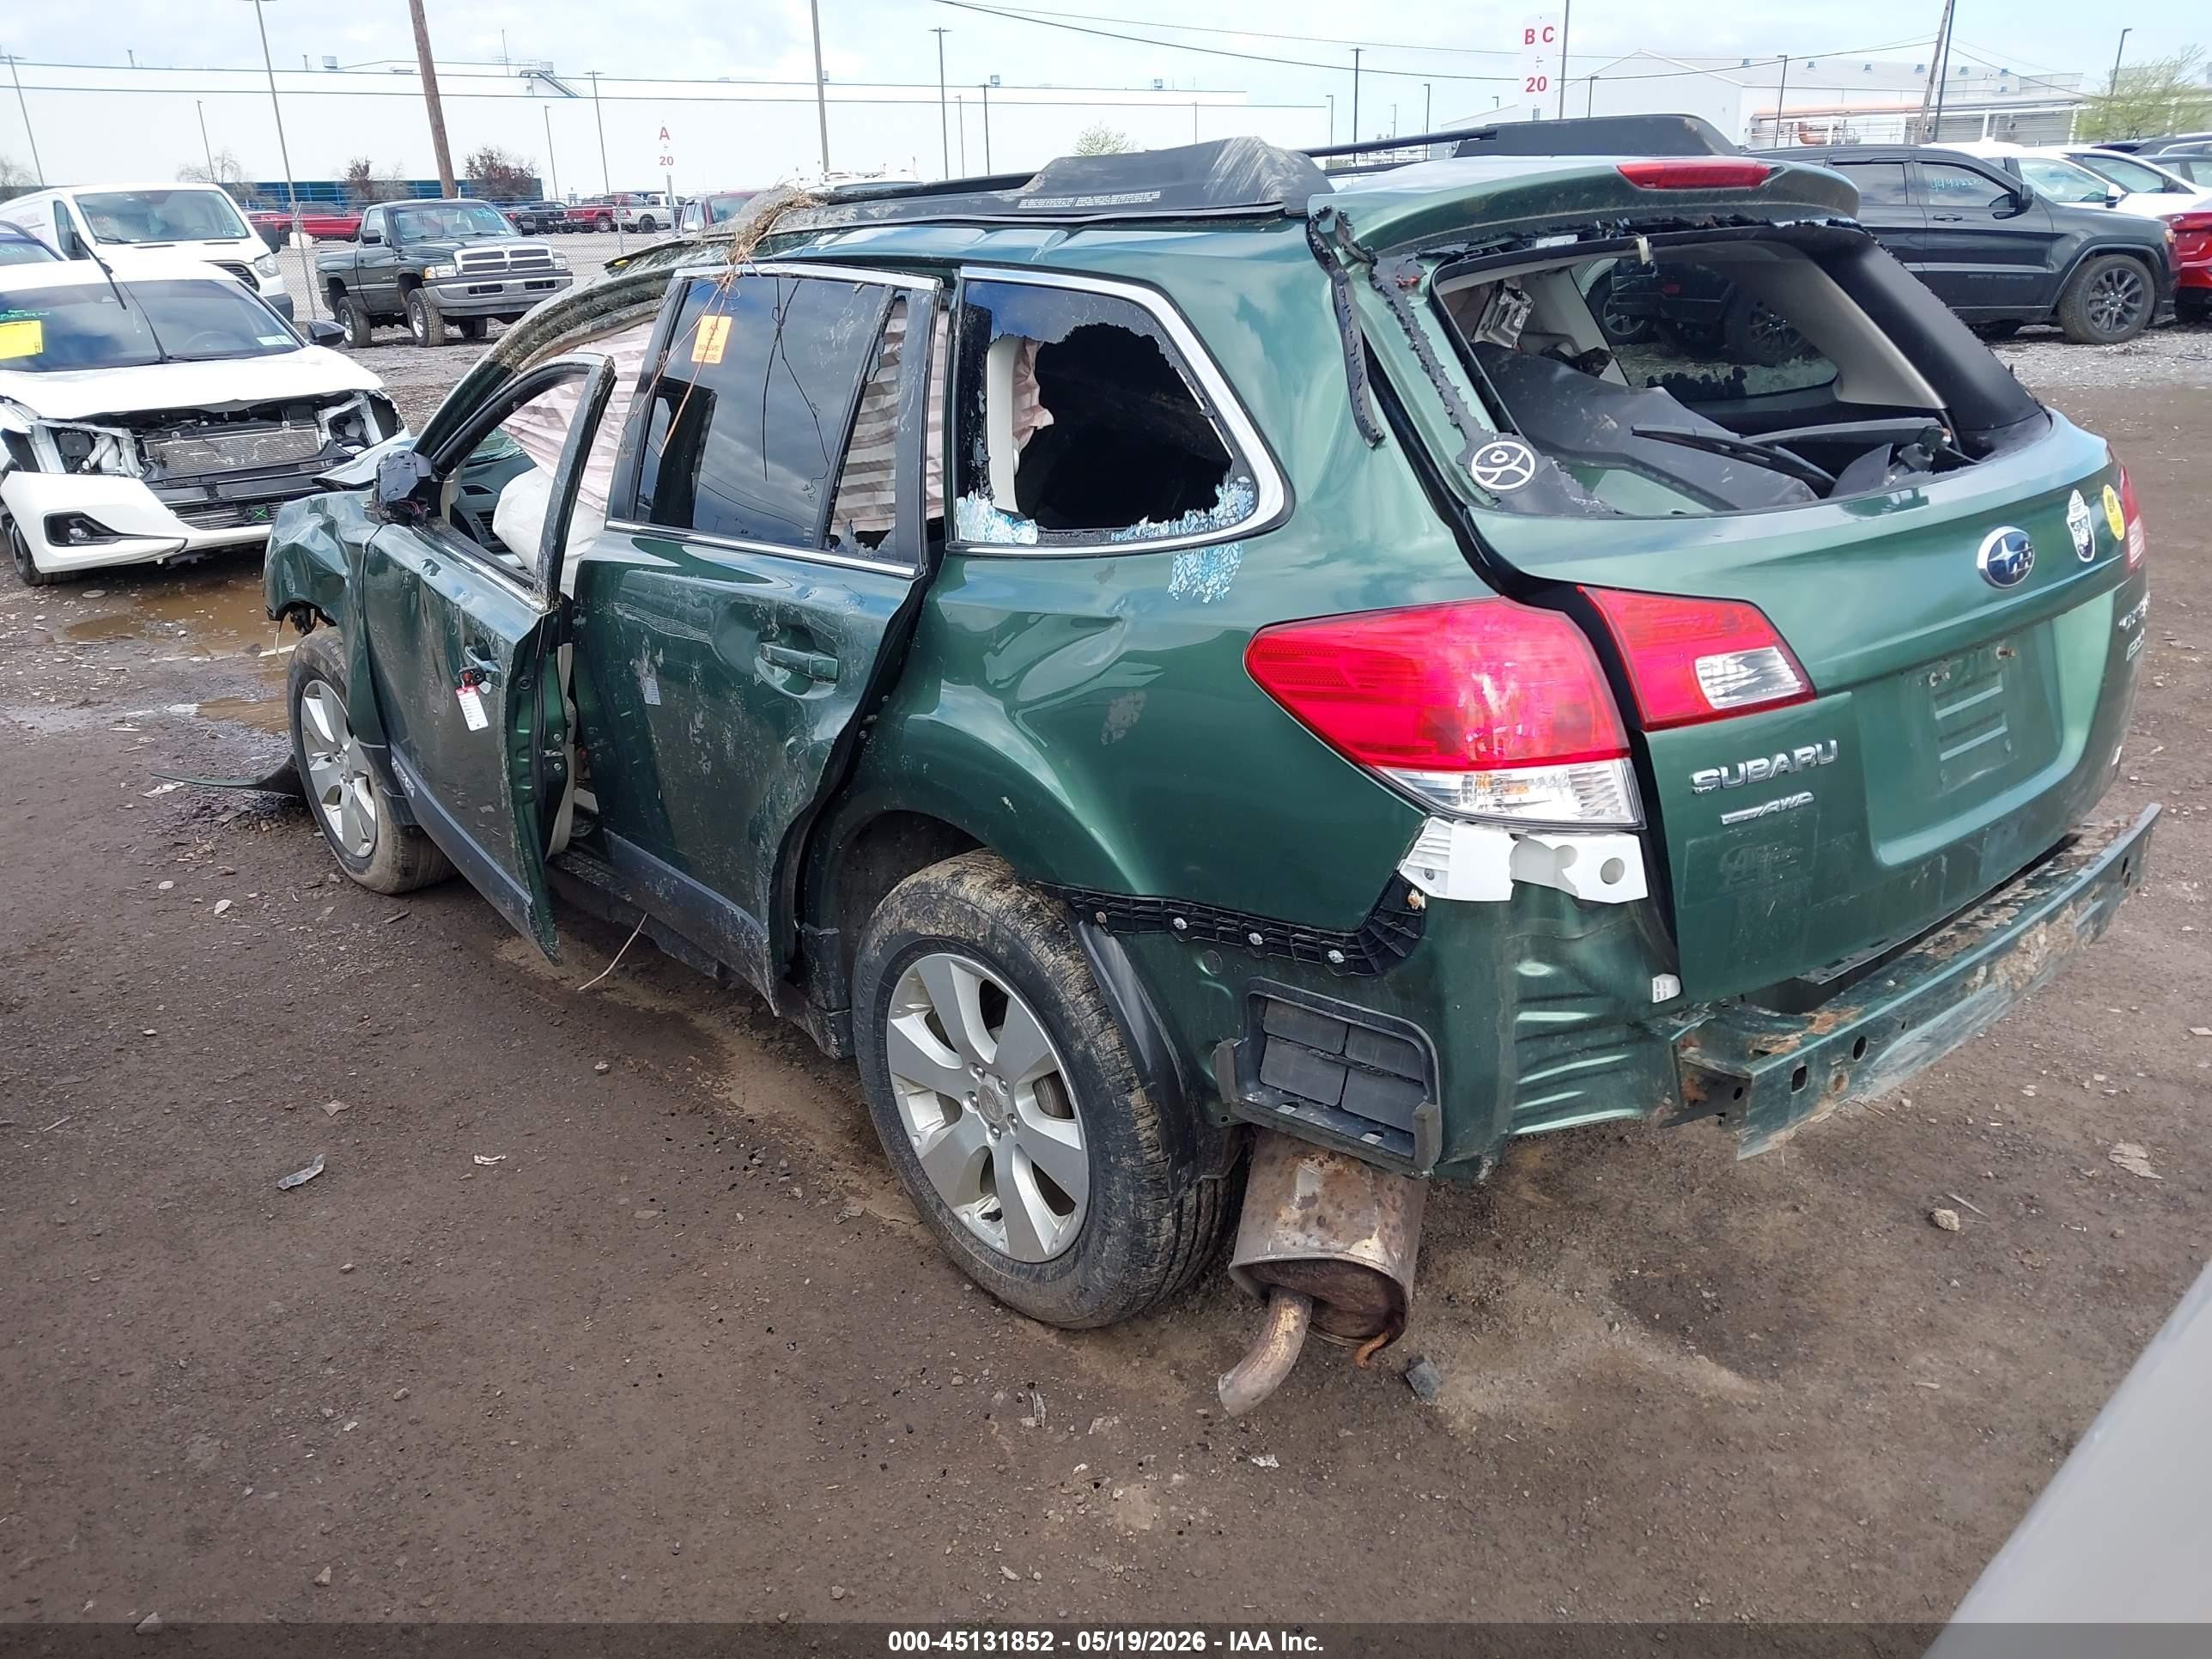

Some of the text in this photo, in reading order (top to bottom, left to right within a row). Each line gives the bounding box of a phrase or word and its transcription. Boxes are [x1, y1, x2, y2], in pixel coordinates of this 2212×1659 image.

[1524, 26, 1555, 45] B C
[1525, 76, 1548, 93] 20
[659, 126, 671, 141] A
[659, 155, 674, 167] 20
[1691, 739, 1838, 795] SUBARU
[1759, 791, 1814, 817] AWD
